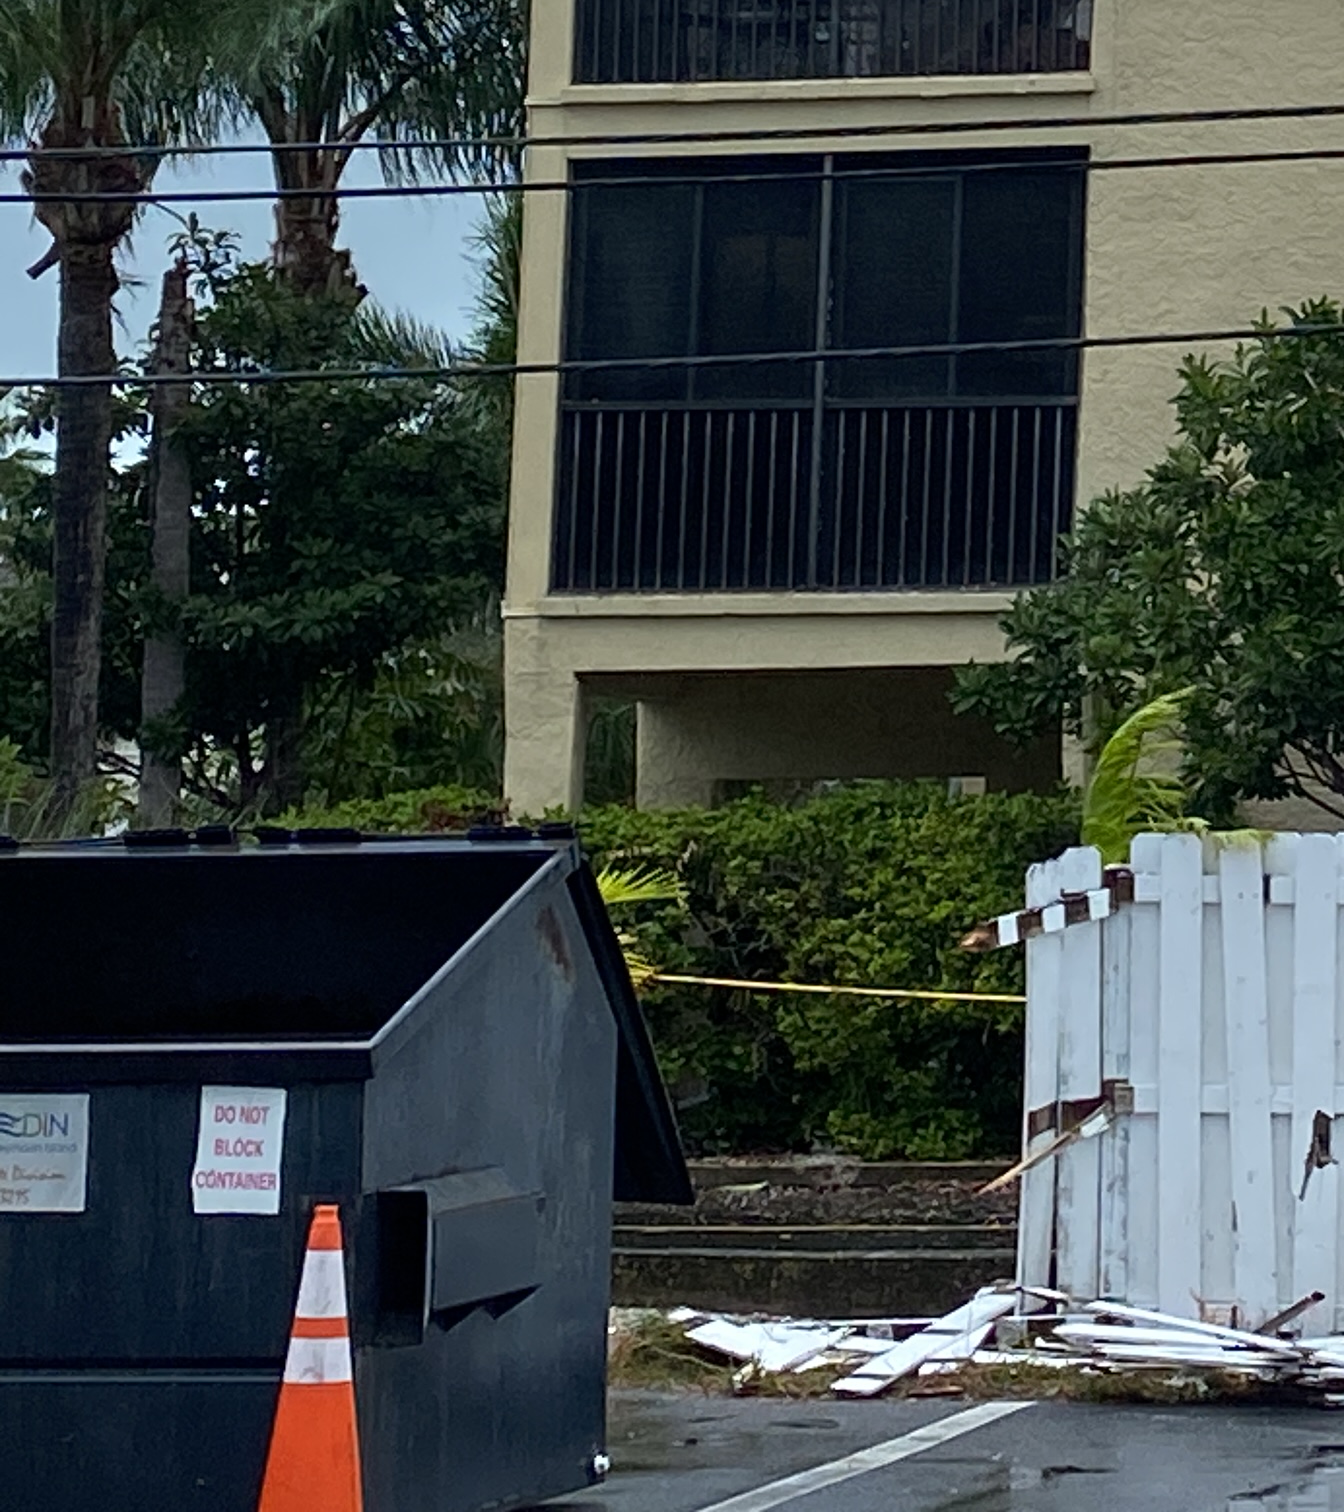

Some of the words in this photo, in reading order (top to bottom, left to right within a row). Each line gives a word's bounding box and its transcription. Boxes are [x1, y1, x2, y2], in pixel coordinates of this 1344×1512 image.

[214, 1105, 236, 1124] DO
[239, 1105, 270, 1125] NOT
[213, 1138, 265, 1157] BLOCK
[196, 1170, 277, 1190] CONTAINER
